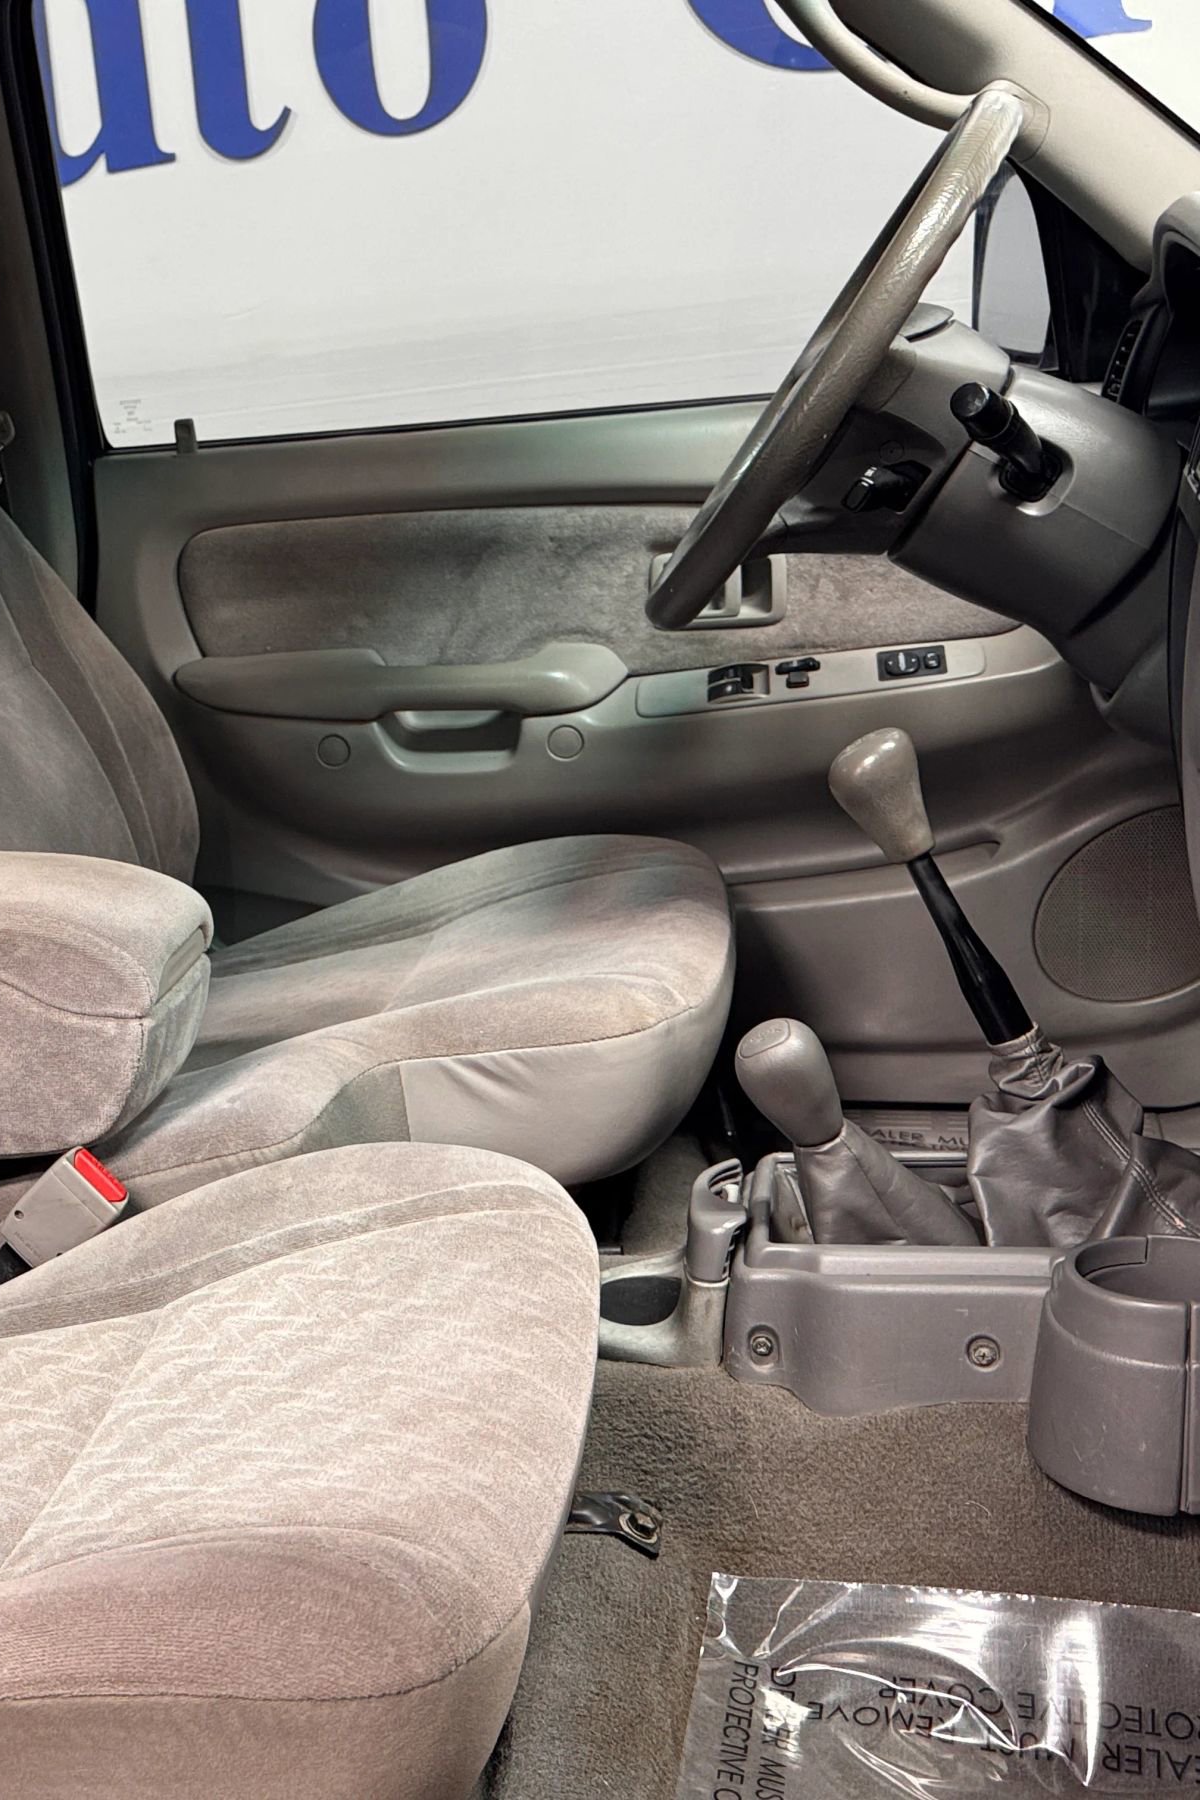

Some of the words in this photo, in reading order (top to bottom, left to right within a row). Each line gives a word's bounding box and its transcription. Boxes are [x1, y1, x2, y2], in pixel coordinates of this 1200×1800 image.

[868, 1128, 924, 1141] ALER
[878, 1675, 1004, 1715] COVER
[1017, 1691, 1200, 1741] OTECTIVE
[716, 1660, 760, 1785] PROTECTIVE
[1102, 1741, 1200, 1785] ALER
